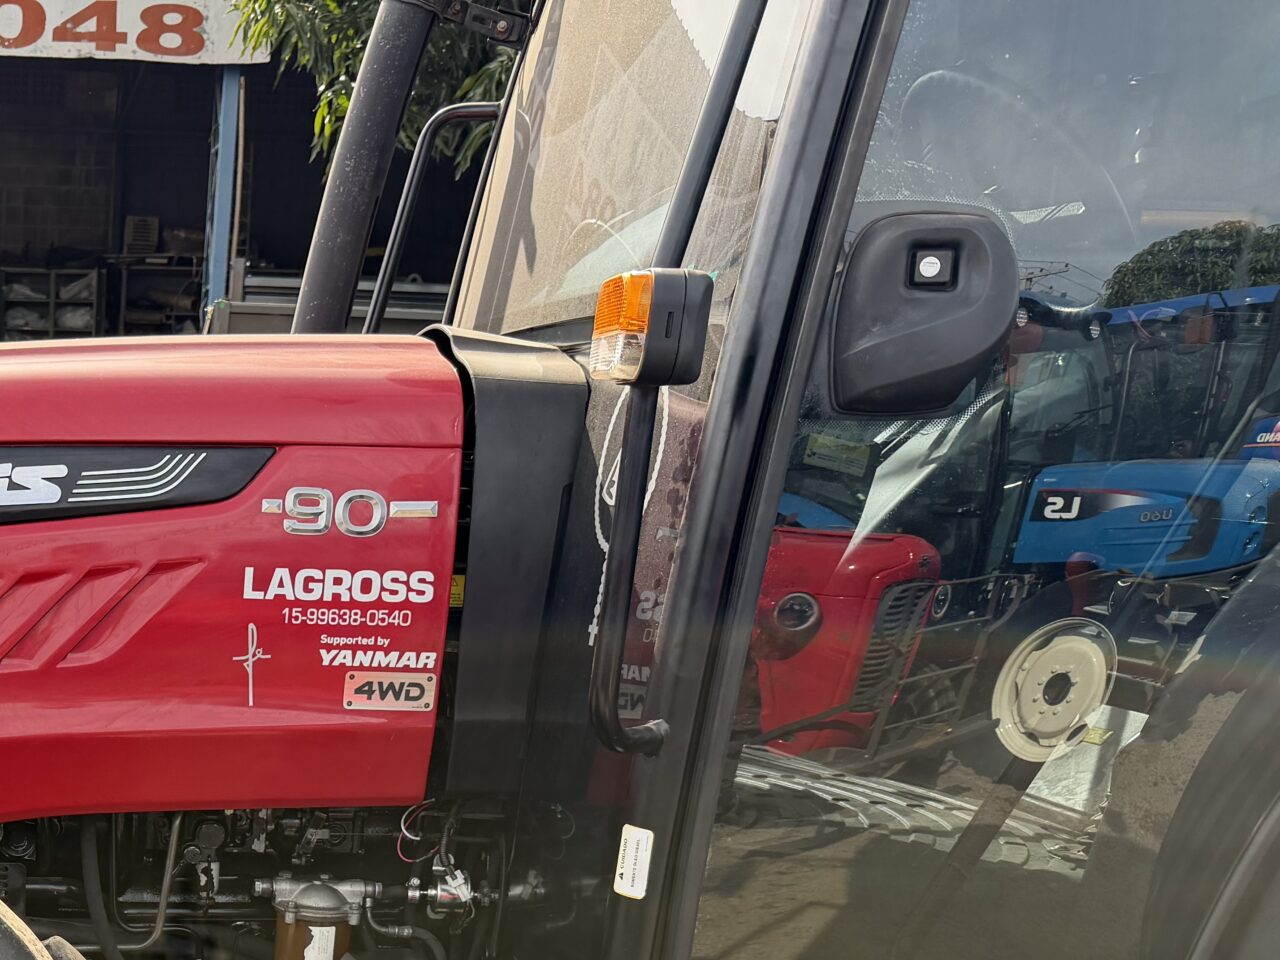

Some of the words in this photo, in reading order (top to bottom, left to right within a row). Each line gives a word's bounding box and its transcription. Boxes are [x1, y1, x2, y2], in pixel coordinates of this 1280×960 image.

[243, 566, 435, 604] LAGROSS
[282, 607, 412, 627] 15-99638-0540
[320, 634, 375, 646] Supported
[377, 637, 391, 647] by
[319, 649, 438, 669] YANMAR
[353, 680, 426, 702] 4WD
